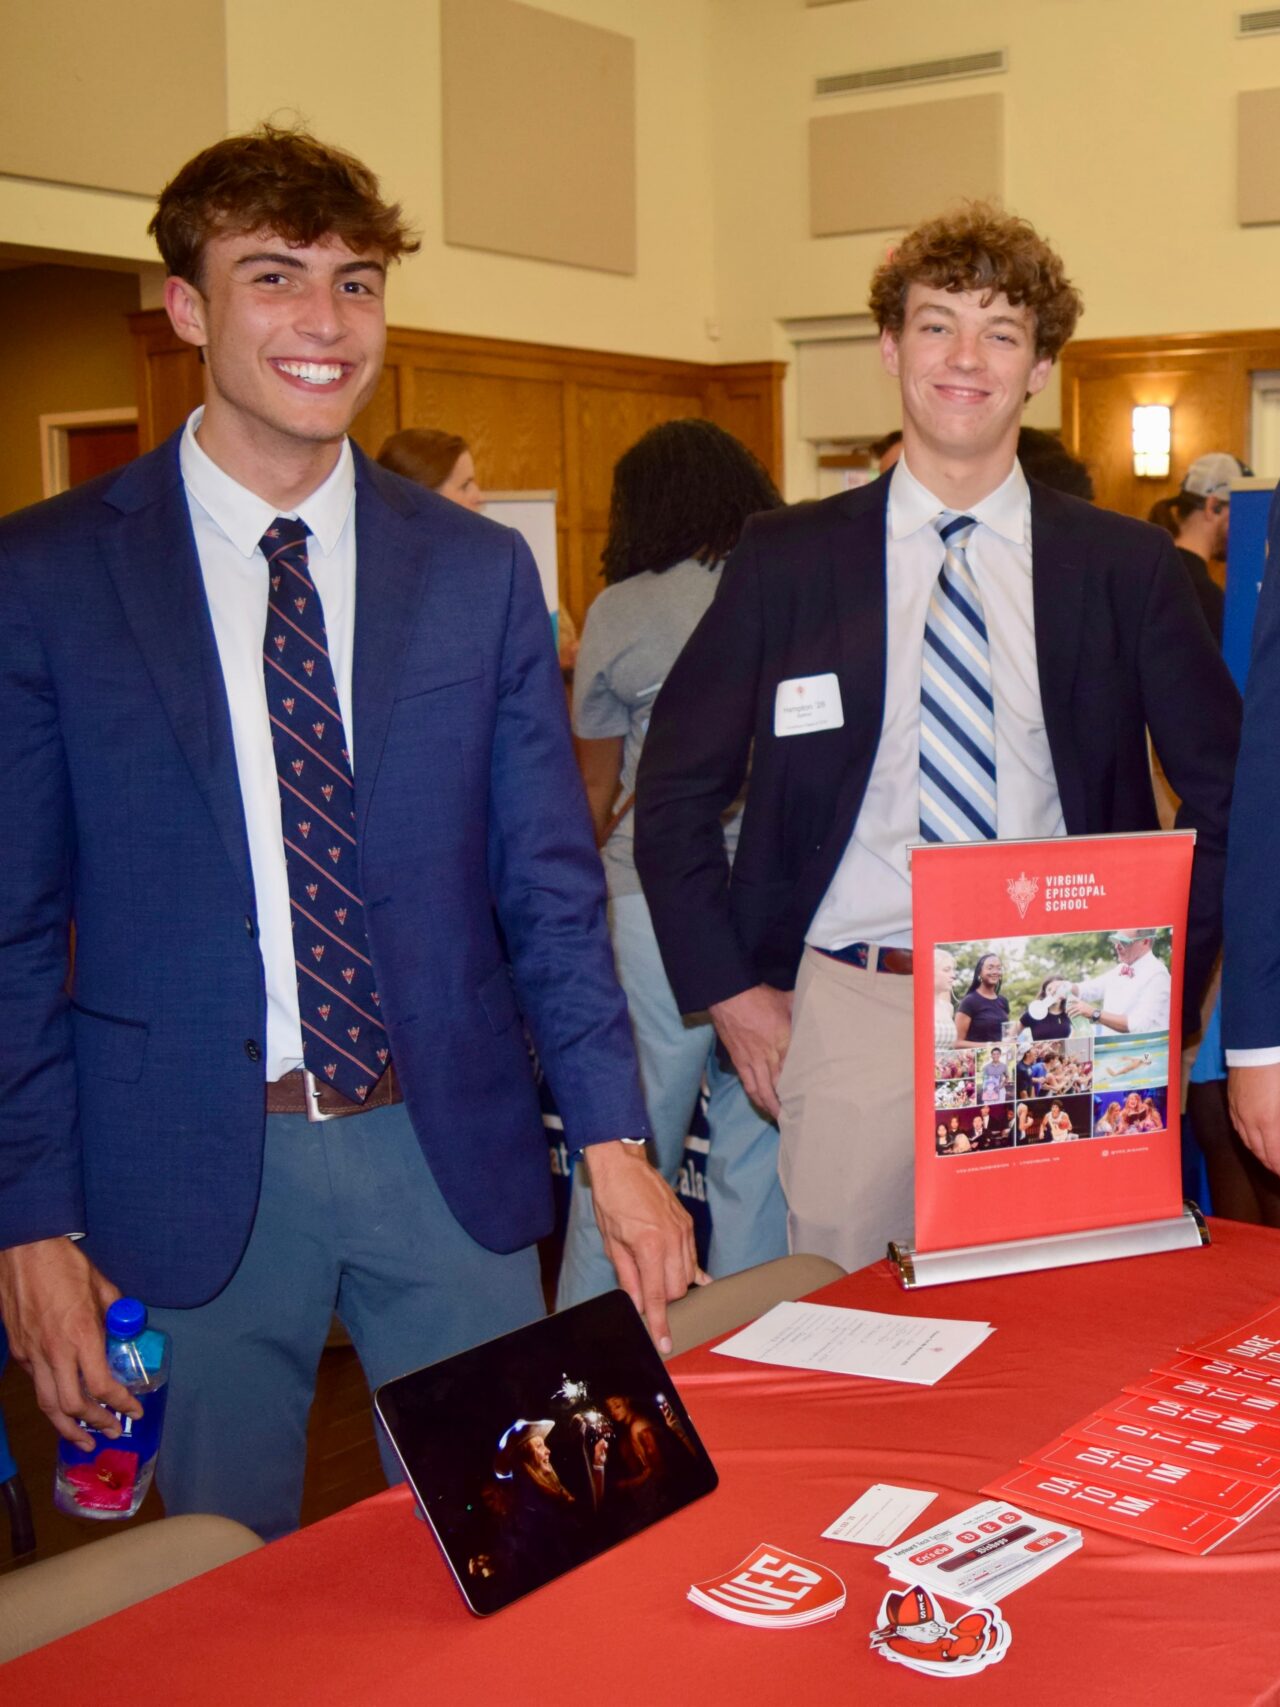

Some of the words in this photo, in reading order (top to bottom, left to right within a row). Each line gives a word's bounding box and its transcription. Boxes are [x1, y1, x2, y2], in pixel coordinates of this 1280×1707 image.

[1045, 872, 1096, 887] VIRGINIA
[1045, 884, 1107, 900] EPISCOPAL
[1045, 898, 1089, 912] SCHOOL
[1181, 1407, 1223, 1424] TO
[1110, 1454, 1154, 1473] TO
[1072, 1485, 1117, 1506] TO
[707, 1553, 823, 1611] VES
[917, 1593, 927, 1619] VES
